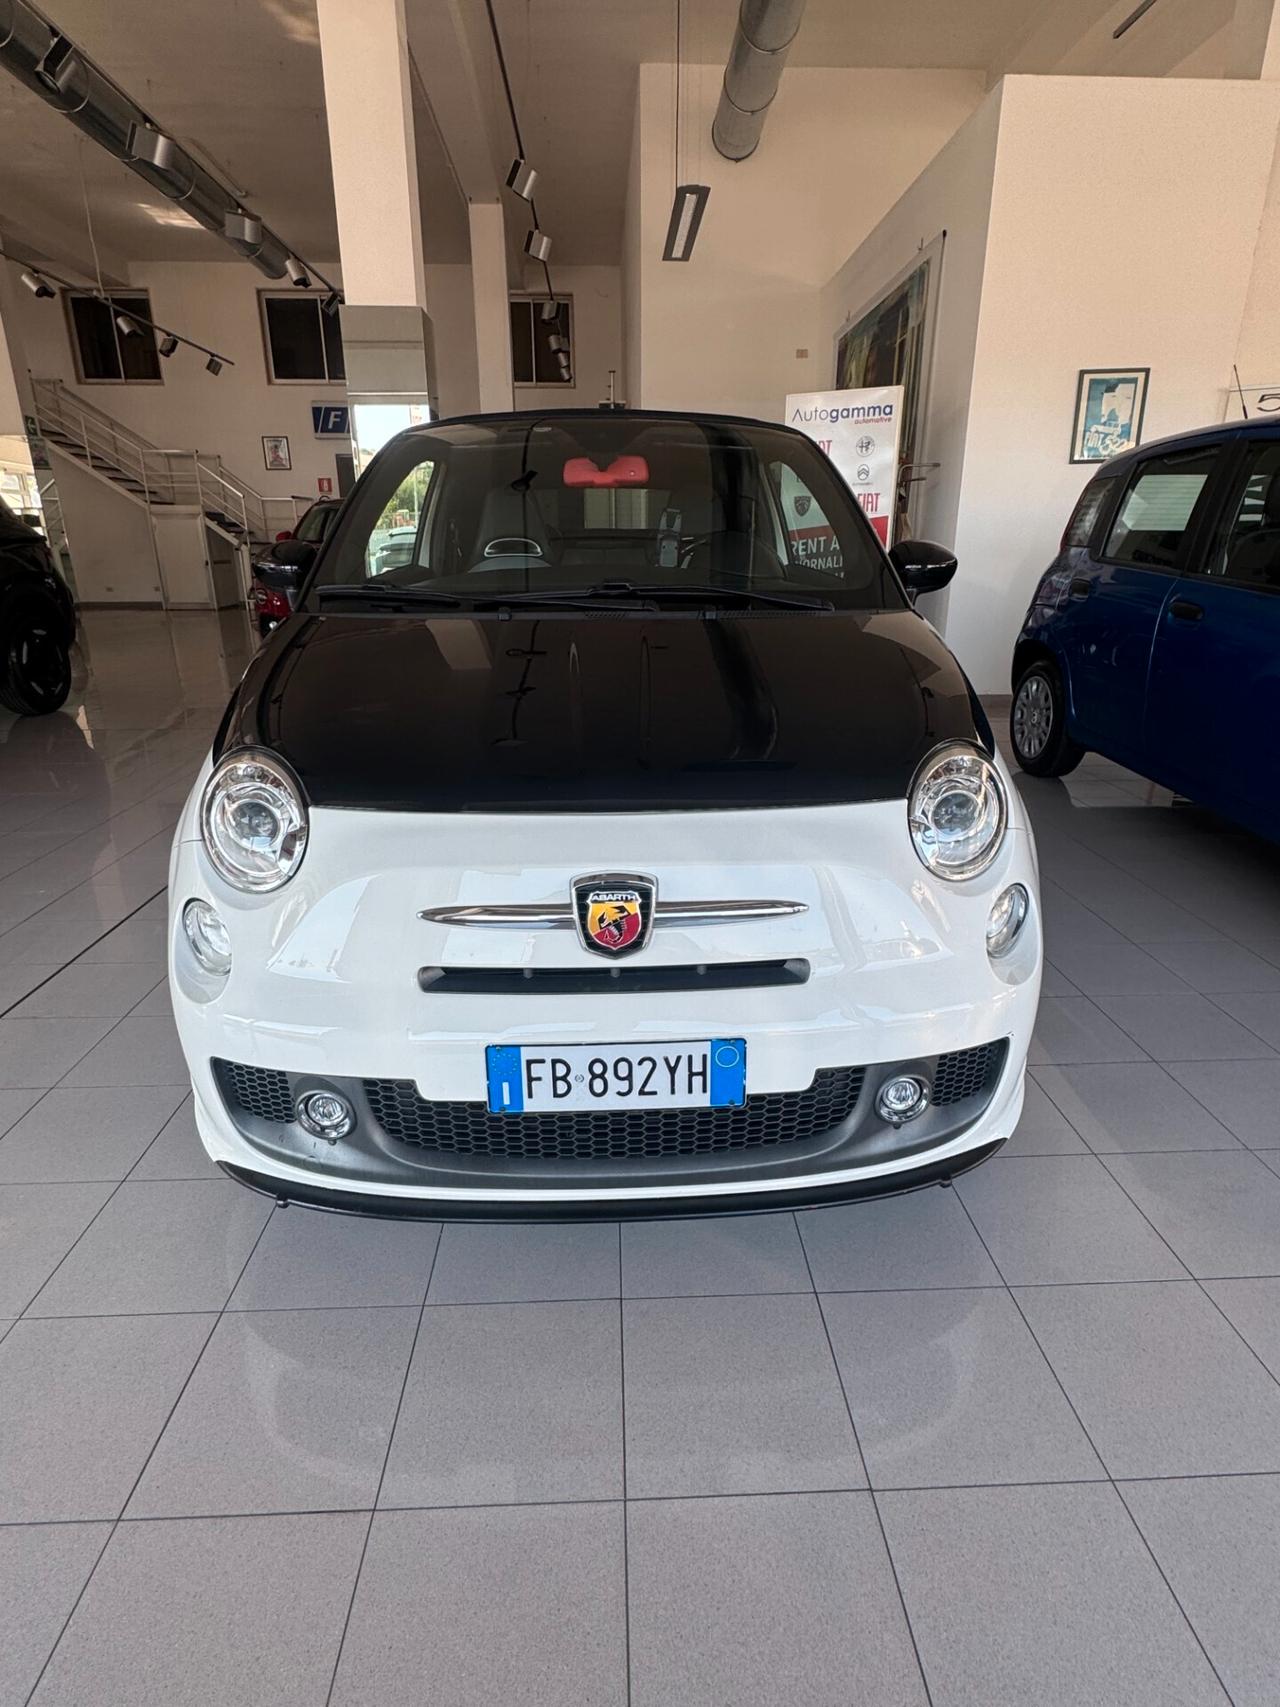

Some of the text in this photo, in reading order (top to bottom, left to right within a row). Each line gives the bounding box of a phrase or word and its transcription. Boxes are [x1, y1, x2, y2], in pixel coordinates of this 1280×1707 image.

[328, 411, 342, 430] F
[792, 404, 893, 423] Autogamma
[854, 417, 892, 425] automotive
[830, 535, 840, 551] A
[592, 893, 636, 901] ABARTH
[525, 1053, 708, 1100] FB 892YH
